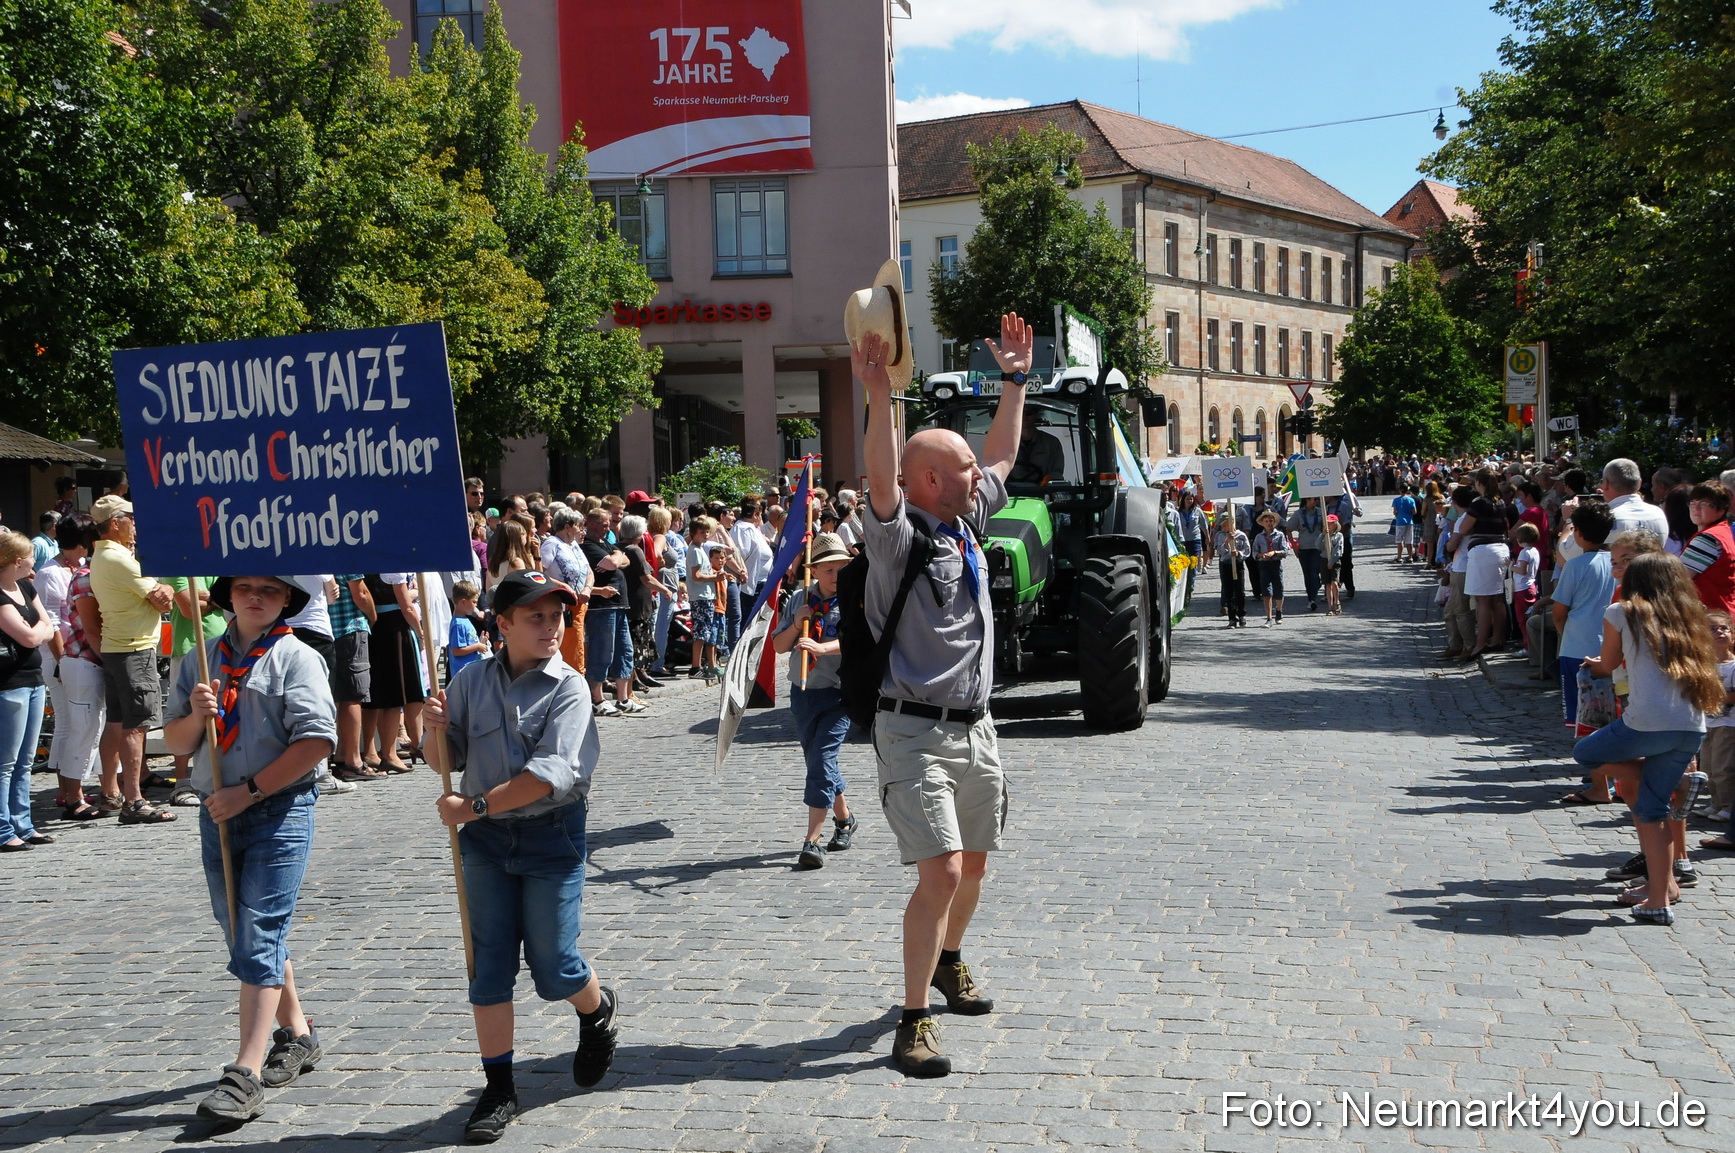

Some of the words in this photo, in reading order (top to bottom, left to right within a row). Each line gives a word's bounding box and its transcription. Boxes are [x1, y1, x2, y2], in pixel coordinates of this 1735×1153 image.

[650, 26, 733, 61] 175
[653, 62, 734, 85] JAHRE
[653, 96, 700, 107] Sparkasse
[702, 94, 789, 105] Neumarkt-Parsberg
[613, 300, 772, 329] Sparkasse
[139, 355, 298, 425] SIEDLUNG
[305, 331, 410, 413] TAIZÉ
[980, 382, 995, 394] NM
[1556, 418, 1572, 430] WC
[143, 432, 259, 489] Verband
[267, 425, 440, 482] Christlicher
[196, 494, 379, 558] Pfadfinder
